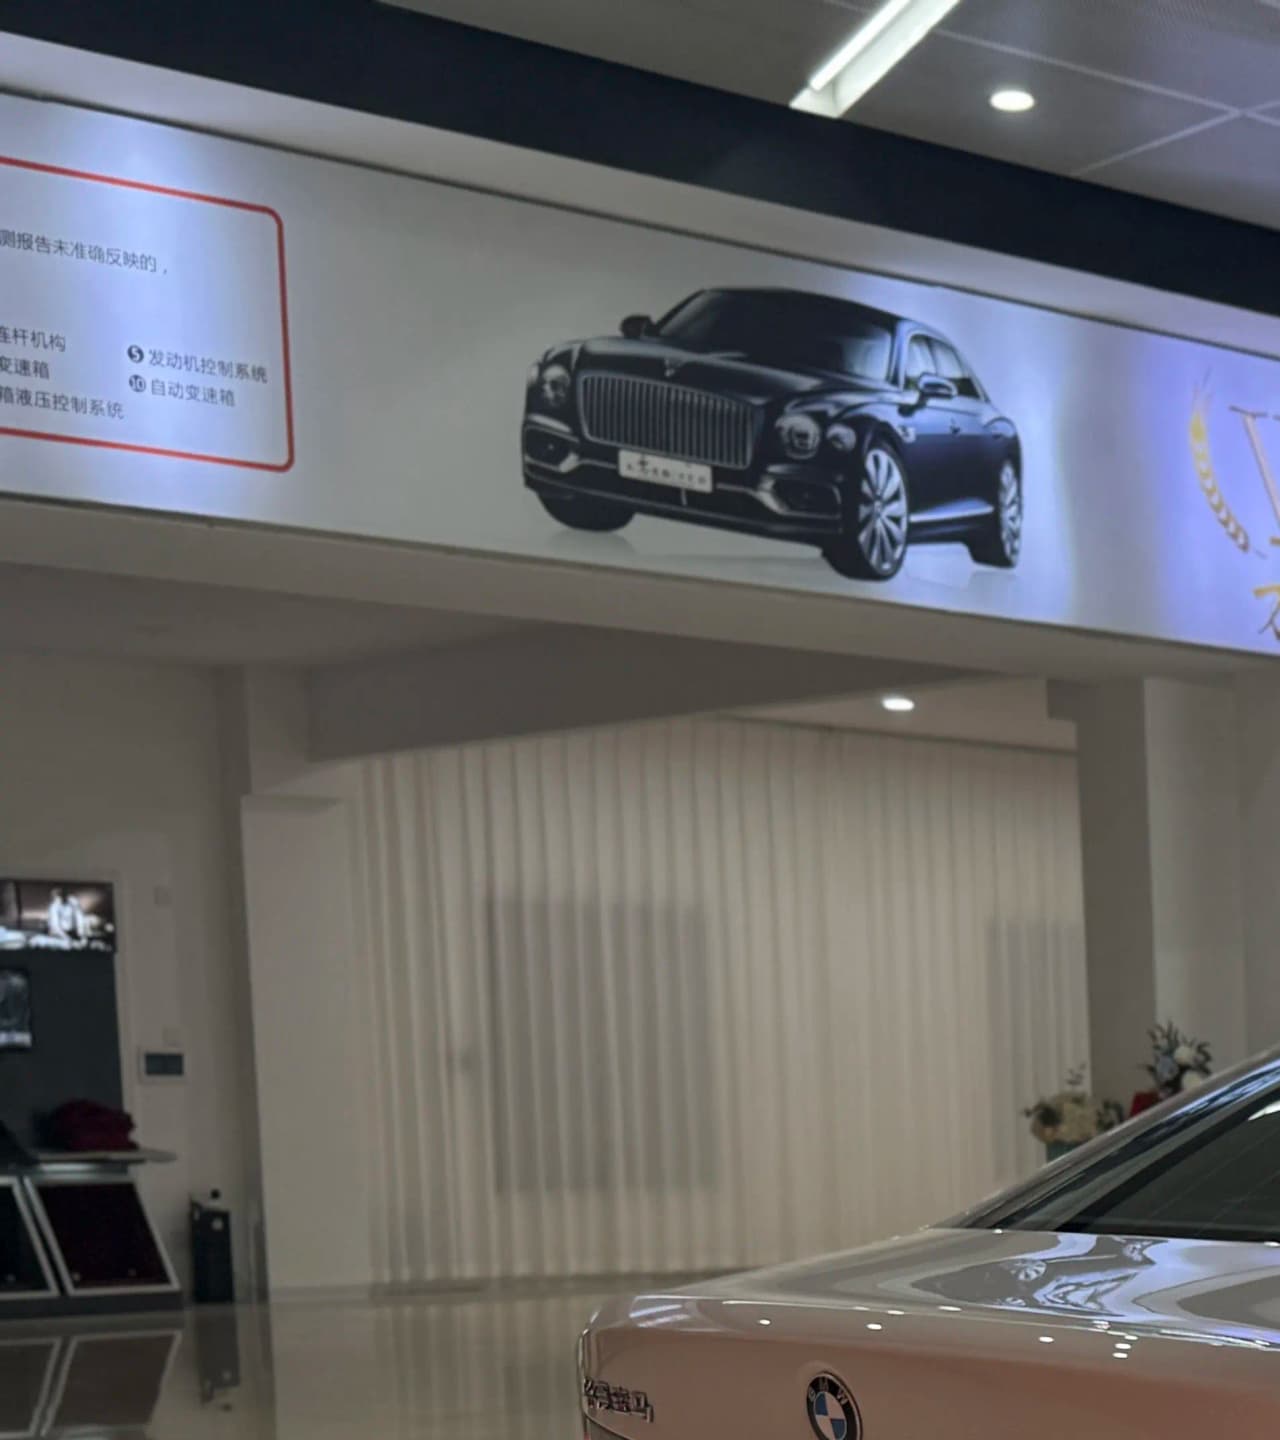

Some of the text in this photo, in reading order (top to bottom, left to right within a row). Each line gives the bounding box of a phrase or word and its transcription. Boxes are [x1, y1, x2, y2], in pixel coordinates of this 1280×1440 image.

[149, 349, 268, 384] 发动机控制系统
[151, 378, 236, 407] 自动变速箱
